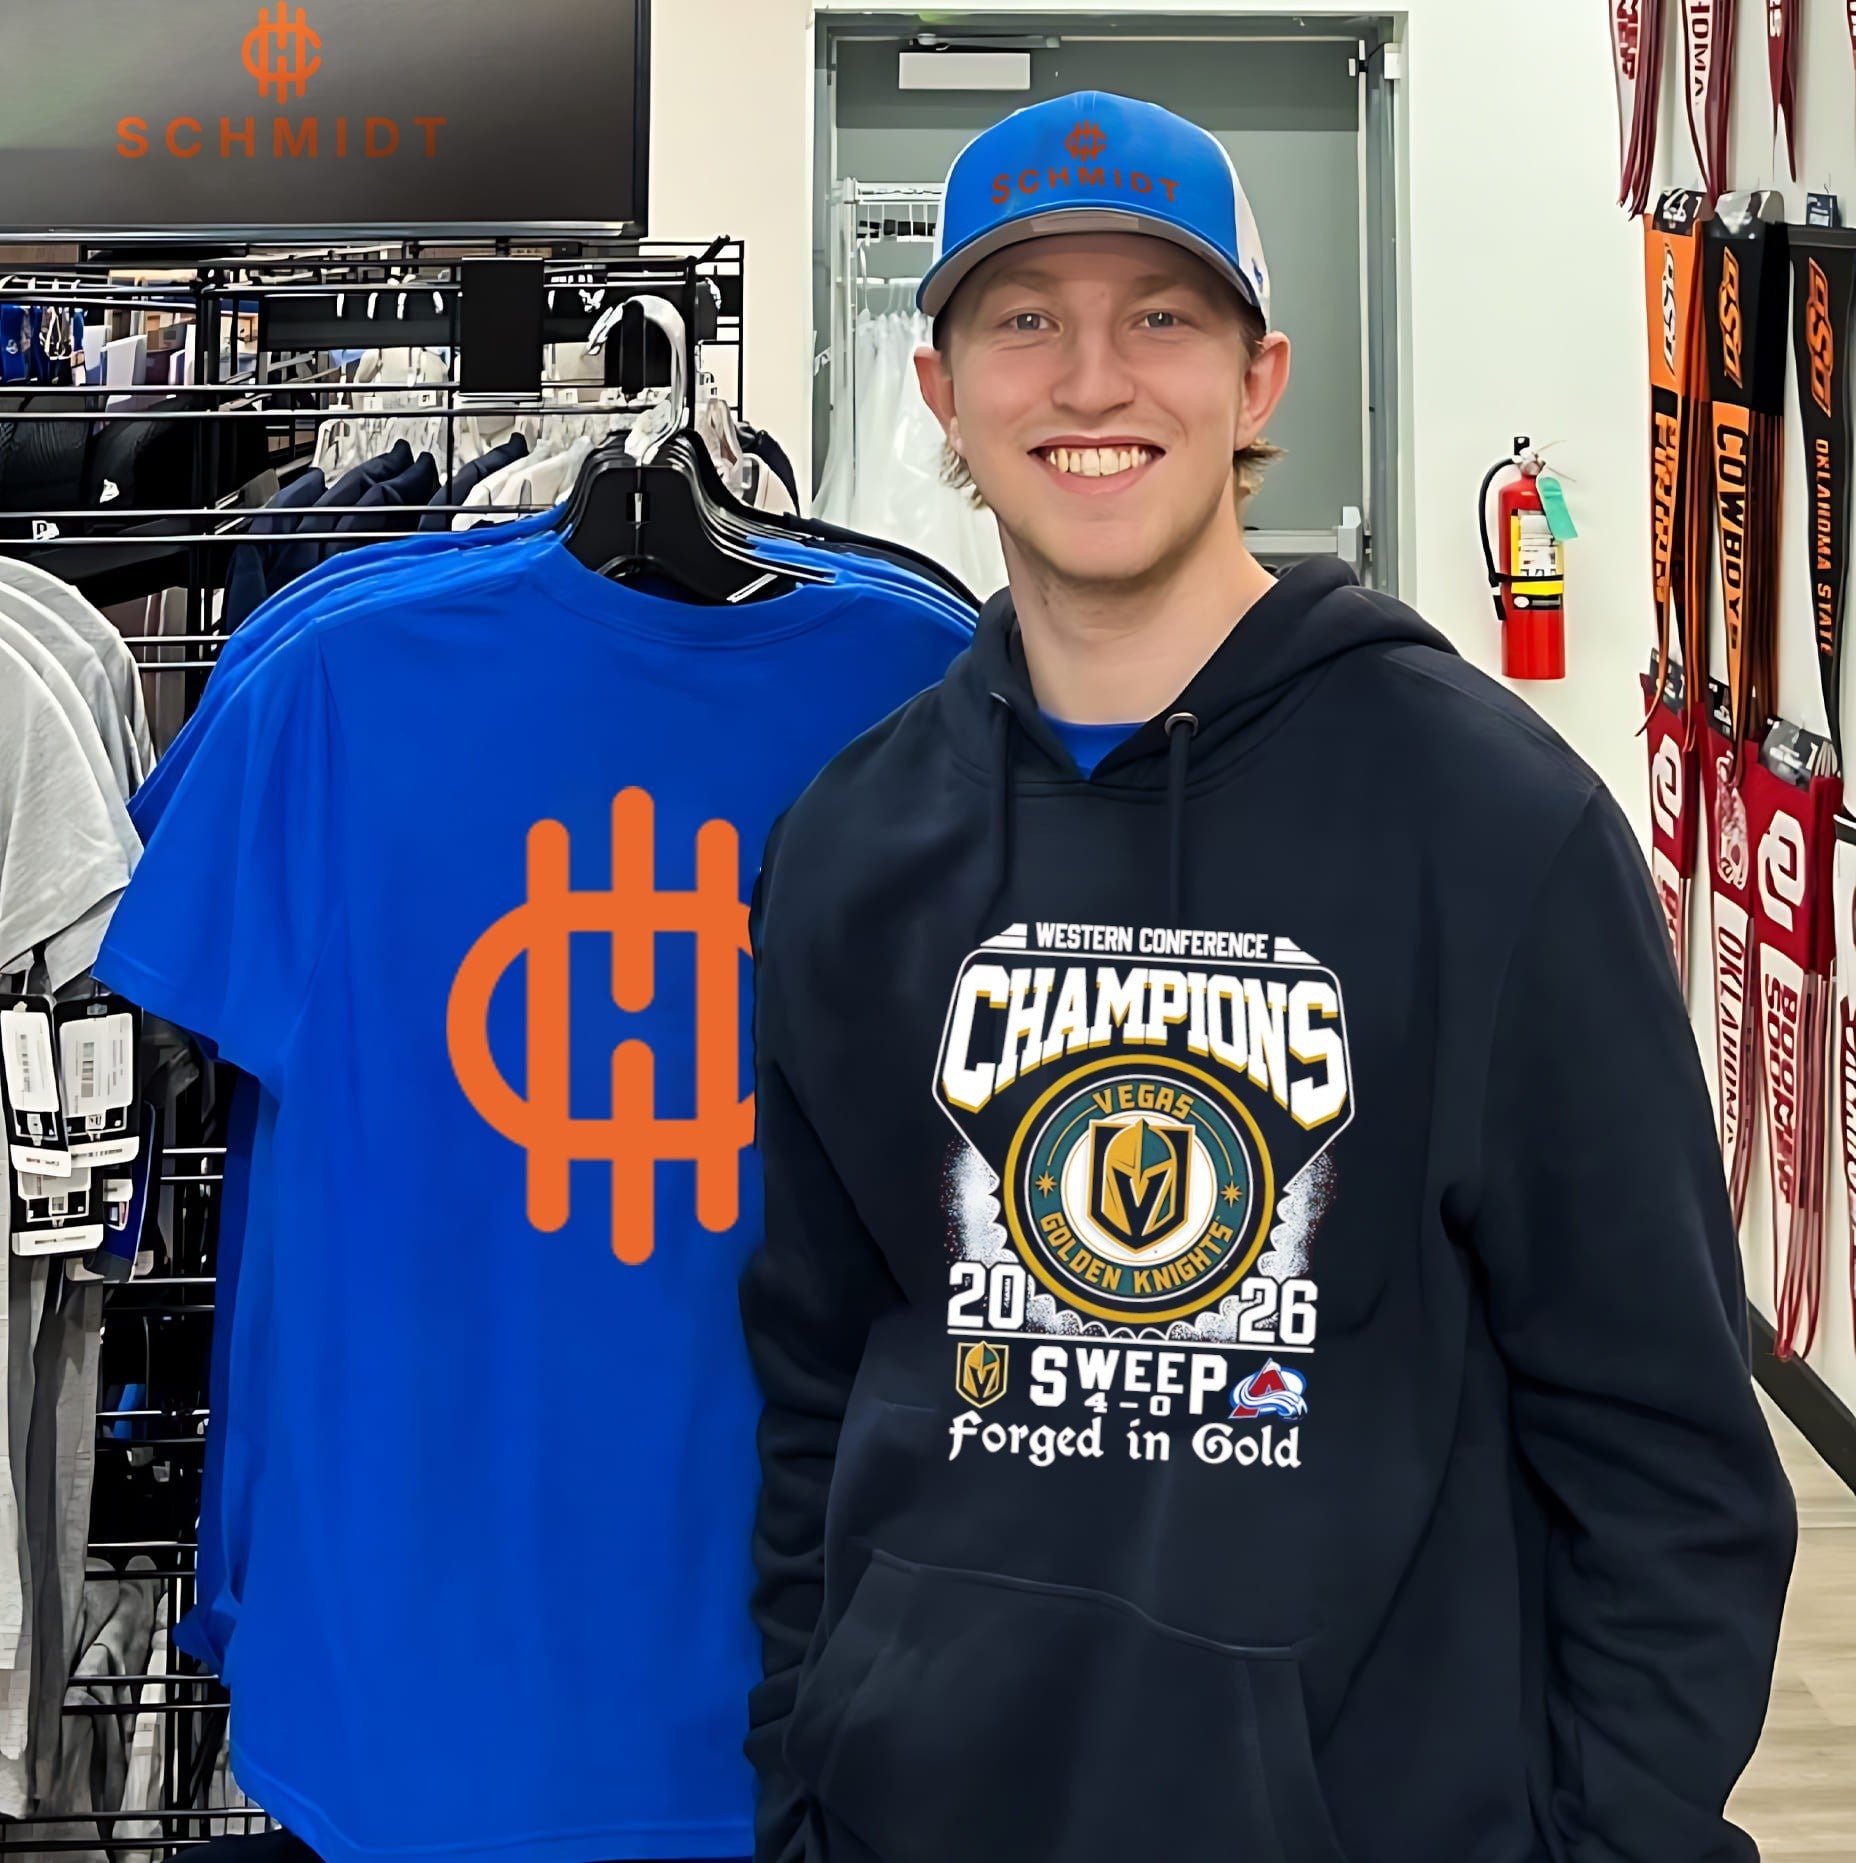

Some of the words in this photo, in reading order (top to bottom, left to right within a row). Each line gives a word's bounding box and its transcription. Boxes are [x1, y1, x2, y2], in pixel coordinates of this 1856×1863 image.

[116, 116, 448, 159] SCHMIDT
[991, 166, 1180, 204] SCHMIDT
[1815, 438, 1832, 571] OKLAHOMA
[1036, 922, 1133, 953] WESTERN
[1139, 927, 1268, 960] CONFERENCE
[941, 964, 1348, 1131] CHAMPIONS
[1717, 926, 1745, 1144] OKLAHOMA
[1092, 1084, 1195, 1120] VEGAS
[1040, 1211, 1123, 1291] GOLDEN
[1133, 1220, 1234, 1294] KNIGHTS
[947, 1262, 1024, 1330] 20
[1238, 1277, 1319, 1346] 26
[1030, 1345, 1228, 1415] SWEEP
[948, 1409, 1104, 1467] Forged
[1126, 1418, 1170, 1462] in
[1191, 1422, 1302, 1468] Gold
